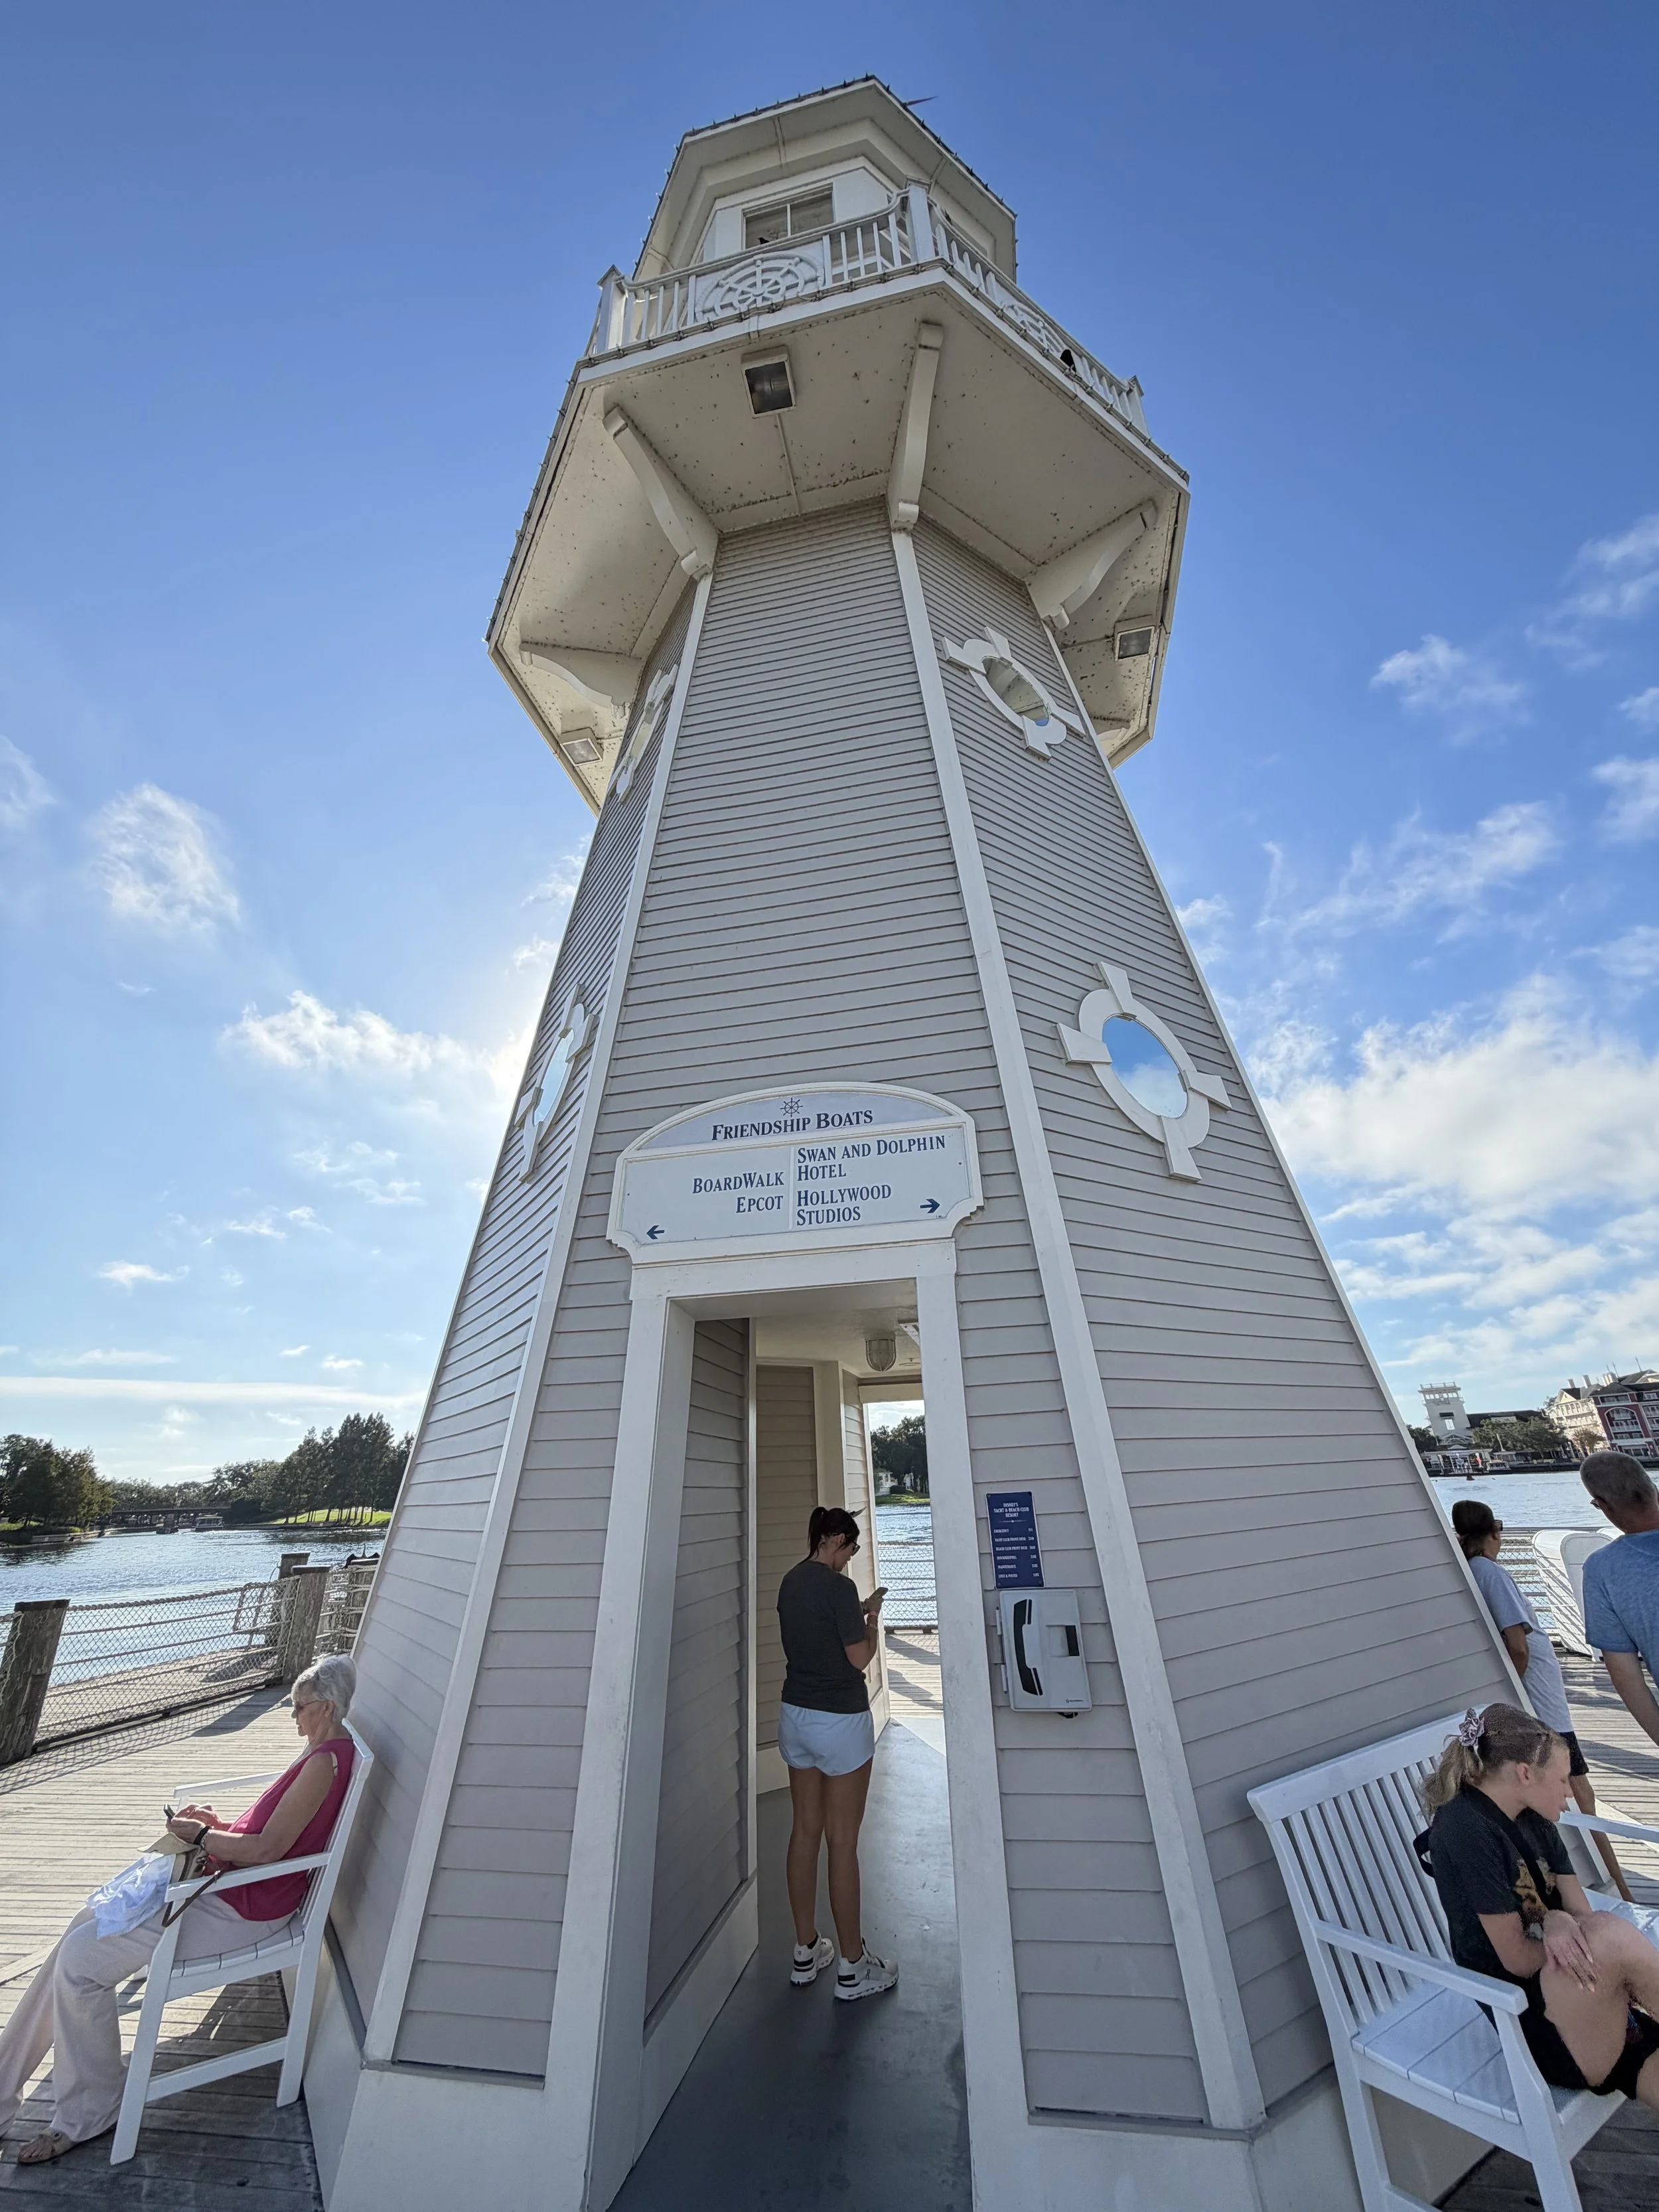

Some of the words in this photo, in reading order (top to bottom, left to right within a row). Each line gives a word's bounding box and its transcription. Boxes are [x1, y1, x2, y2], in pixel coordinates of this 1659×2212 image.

[711, 1116, 811, 1141] FRIENDSHIP
[816, 1110, 874, 1130] BOATS
[797, 1147, 837, 1164] SWAN
[841, 1143, 871, 1158] AND
[876, 1135, 946, 1155] DOLPHIN
[797, 1163, 847, 1181] HOTEL
[797, 1185, 892, 1207] HOLLYWOOD
[796, 1206, 861, 1226] STUDIOS
